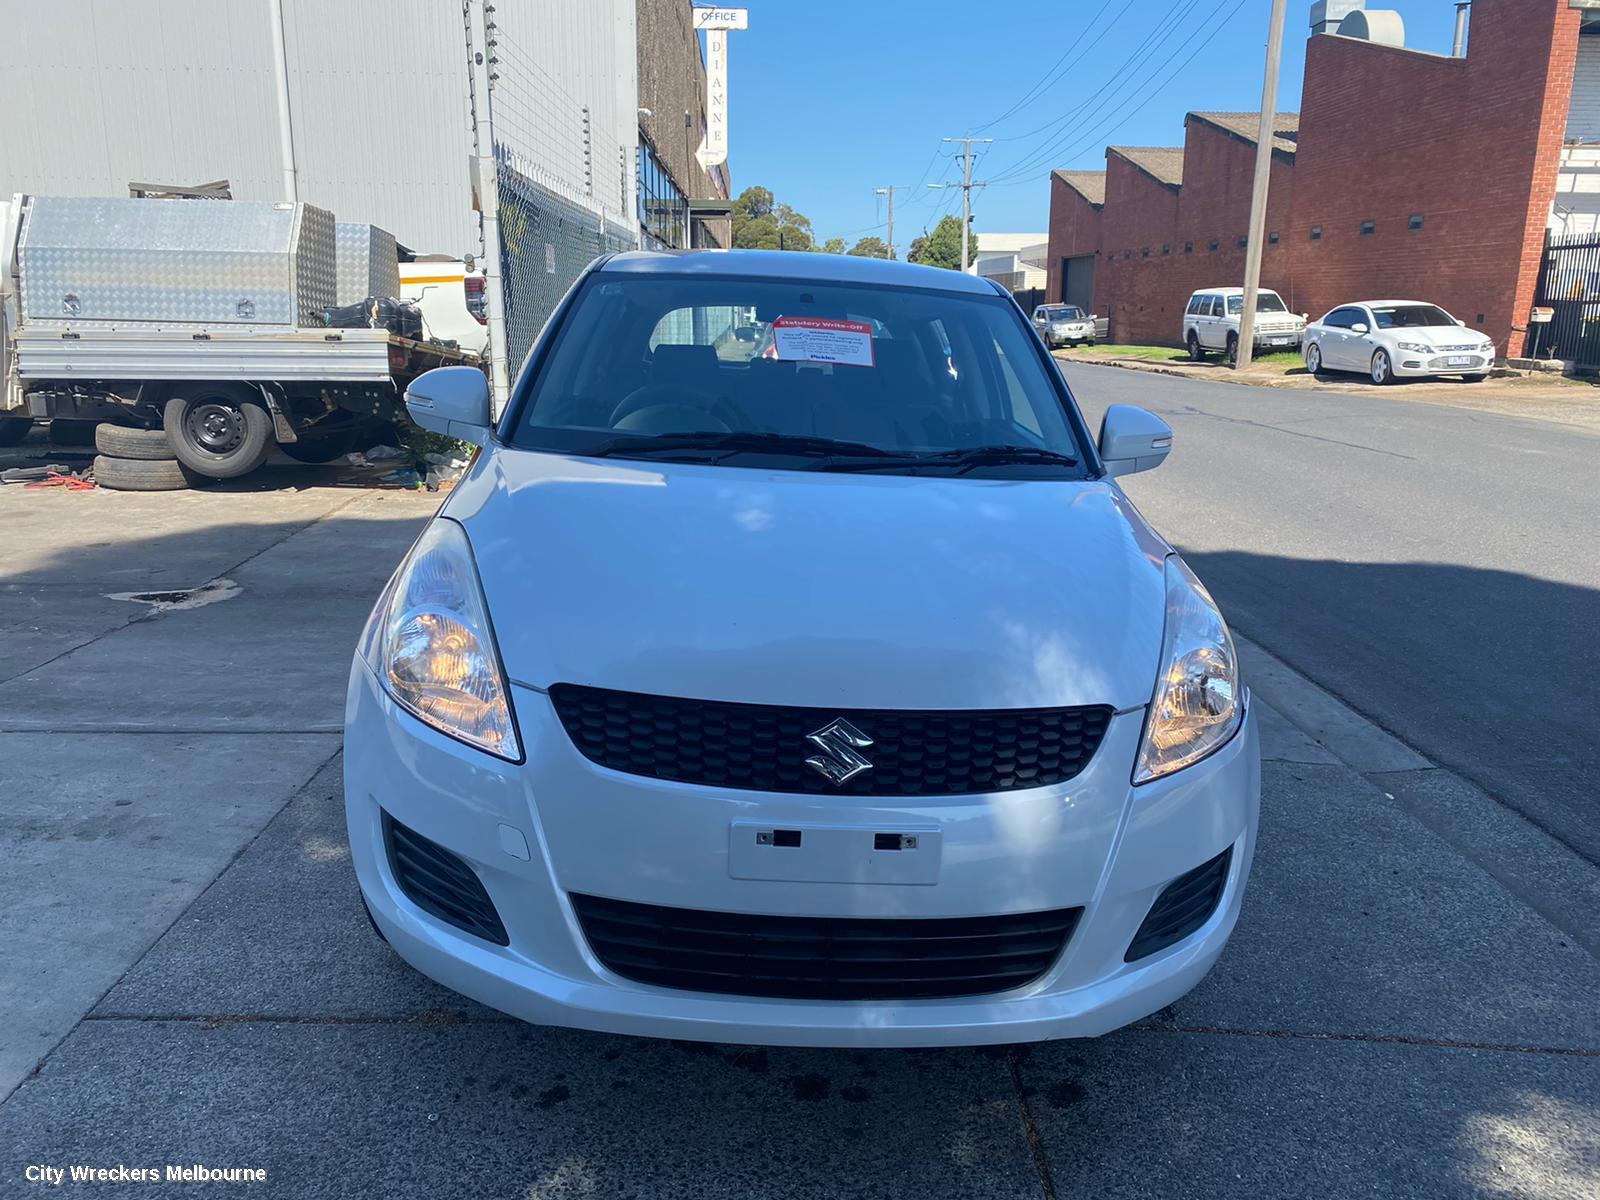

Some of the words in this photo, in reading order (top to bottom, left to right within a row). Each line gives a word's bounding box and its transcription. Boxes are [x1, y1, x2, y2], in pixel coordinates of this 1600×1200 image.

[701, 12, 737, 21] OFFICE
[712, 42, 722, 141] DIANNE
[780, 320, 821, 328] Statutory
[822, 322, 864, 330] Write-Off
